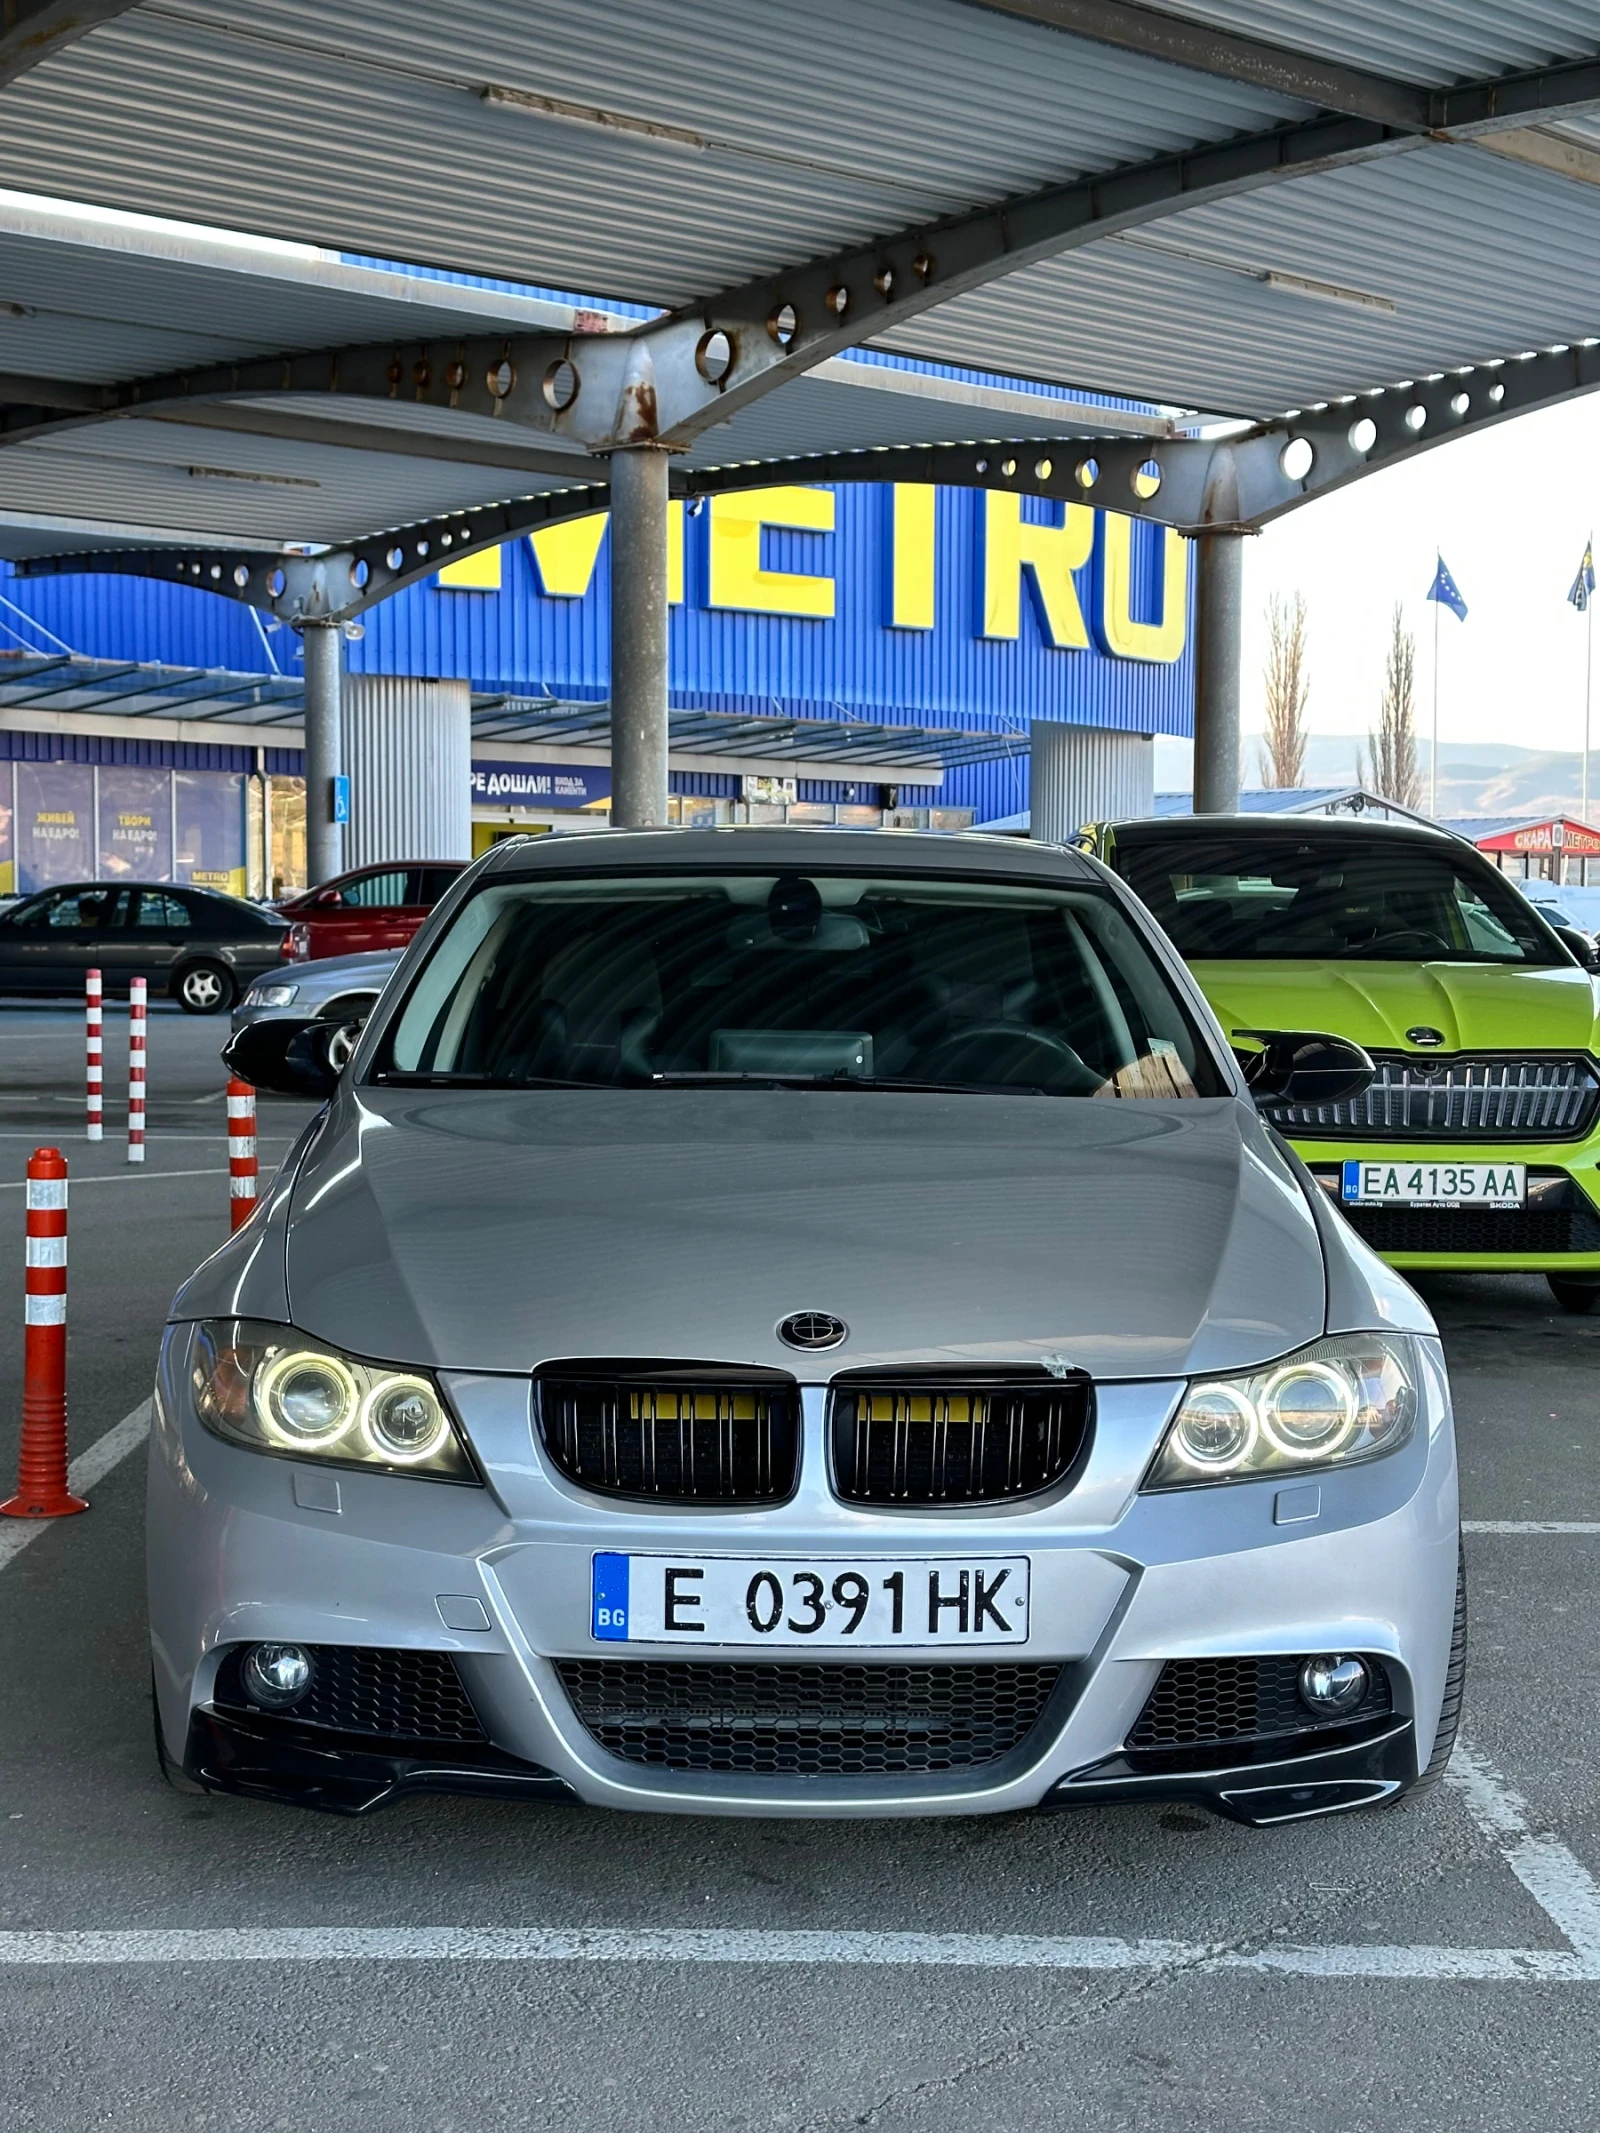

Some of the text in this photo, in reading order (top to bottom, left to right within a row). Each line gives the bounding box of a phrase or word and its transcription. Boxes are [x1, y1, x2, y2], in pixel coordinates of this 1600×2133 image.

[487, 773, 551, 796] ДОШЛИ!
[1514, 828, 1552, 849] СКАРА
[192, 871, 229, 882] METRO
[1345, 1185, 1358, 1193] BG
[1364, 1167, 1518, 1196] EA 4135 AA
[663, 1567, 1013, 1635] E 0391 HK
[597, 1608, 625, 1627] BG
